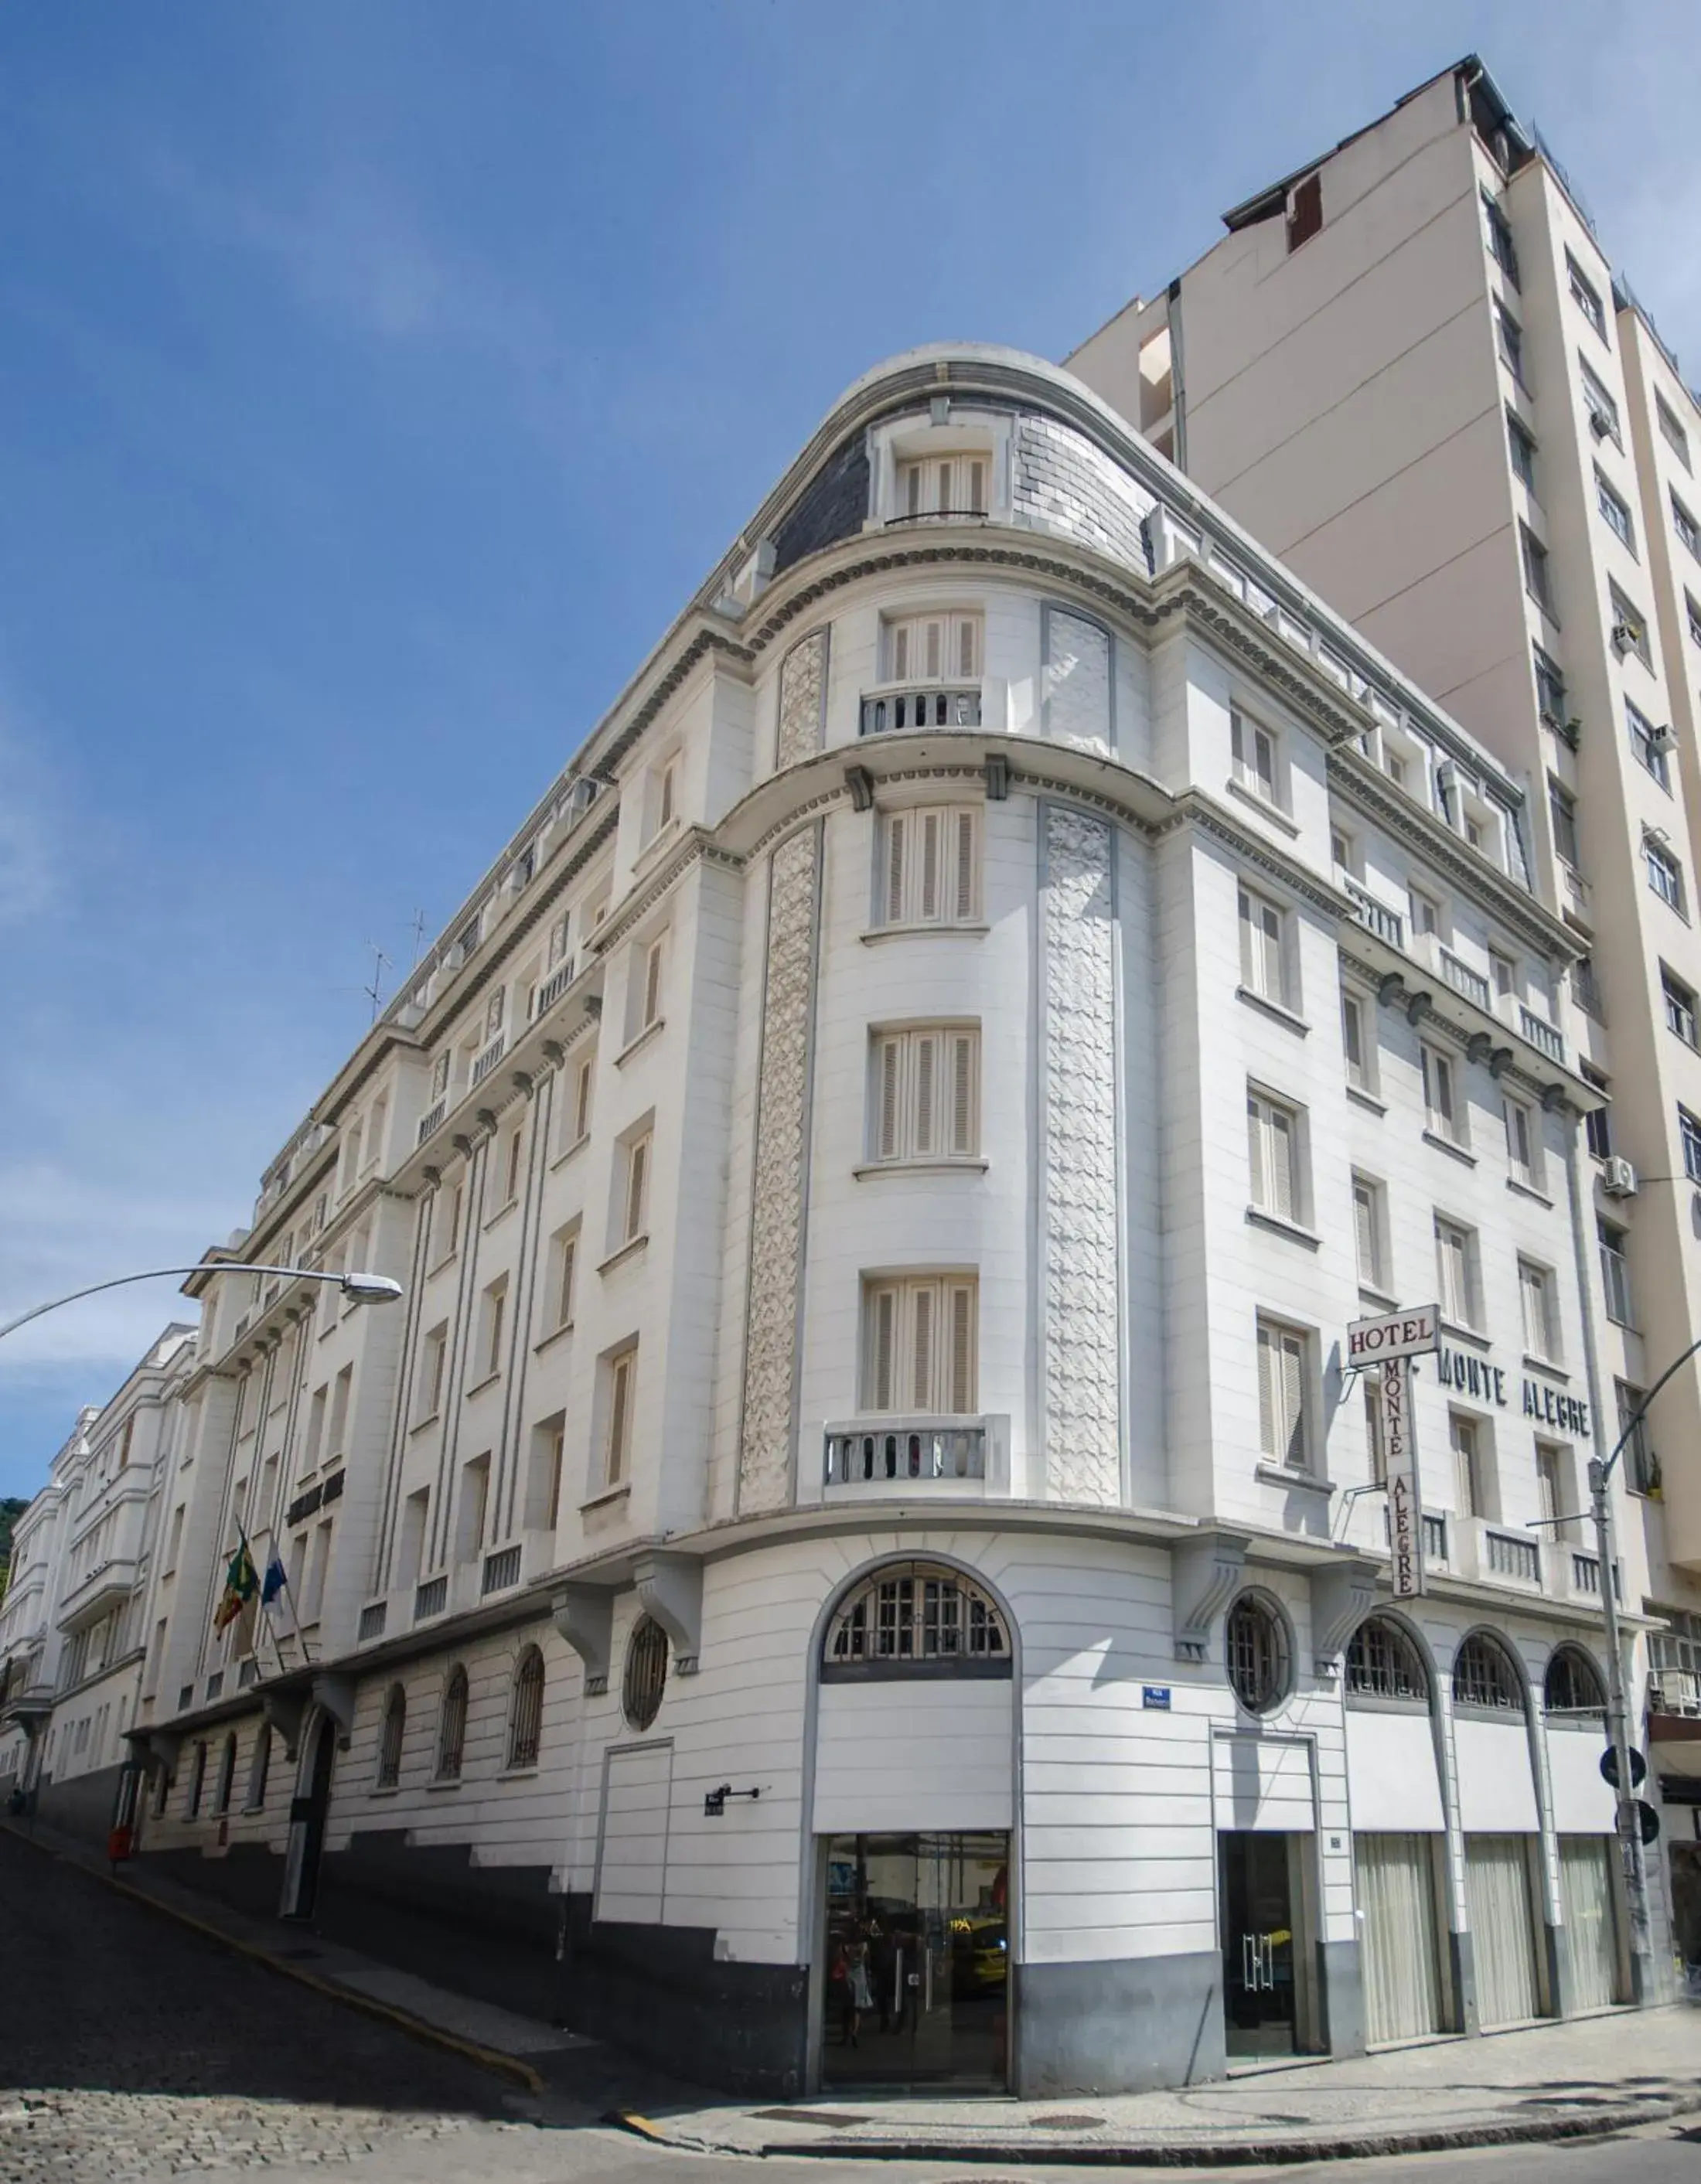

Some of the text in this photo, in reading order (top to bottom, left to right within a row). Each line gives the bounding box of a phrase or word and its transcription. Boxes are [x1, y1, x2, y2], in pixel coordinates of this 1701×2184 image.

[1350, 1317, 1434, 1354] HOTEL
[1438, 1348, 1590, 1437] MONTE ALEGRE
[1385, 1359, 1413, 1594] MONTE ALEGRE
